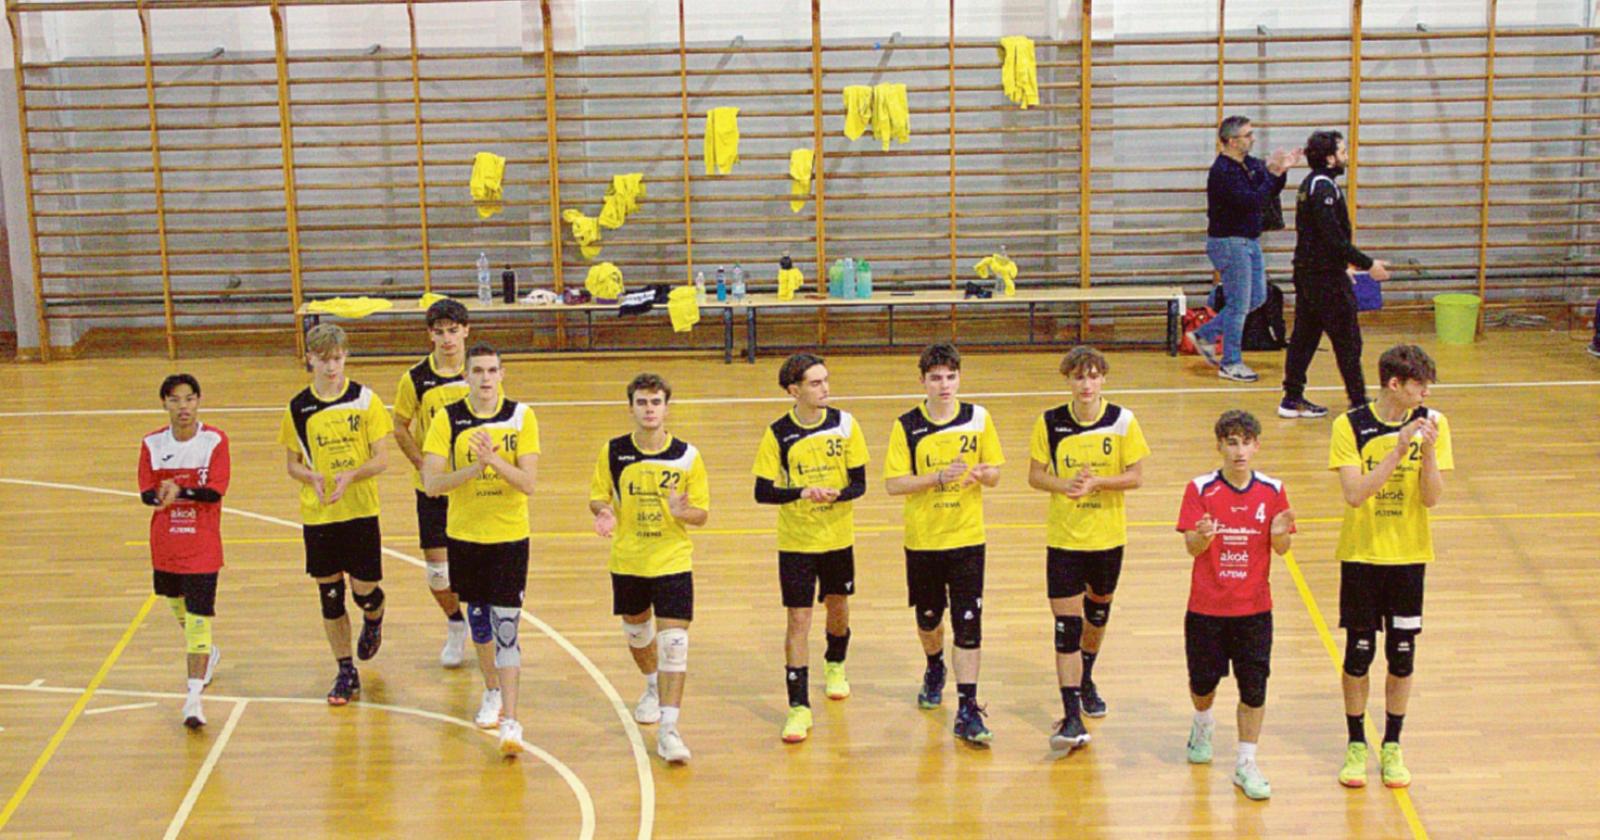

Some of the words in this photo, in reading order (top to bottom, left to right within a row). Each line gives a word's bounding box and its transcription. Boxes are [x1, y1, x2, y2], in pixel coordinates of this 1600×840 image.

[347, 414, 361, 432] 18
[502, 434, 518, 452] 16
[826, 439, 843, 457] 35
[960, 435, 978, 453] 24
[1103, 437, 1112, 455] 6
[659, 470, 681, 490] 22
[1255, 502, 1266, 523] 4
